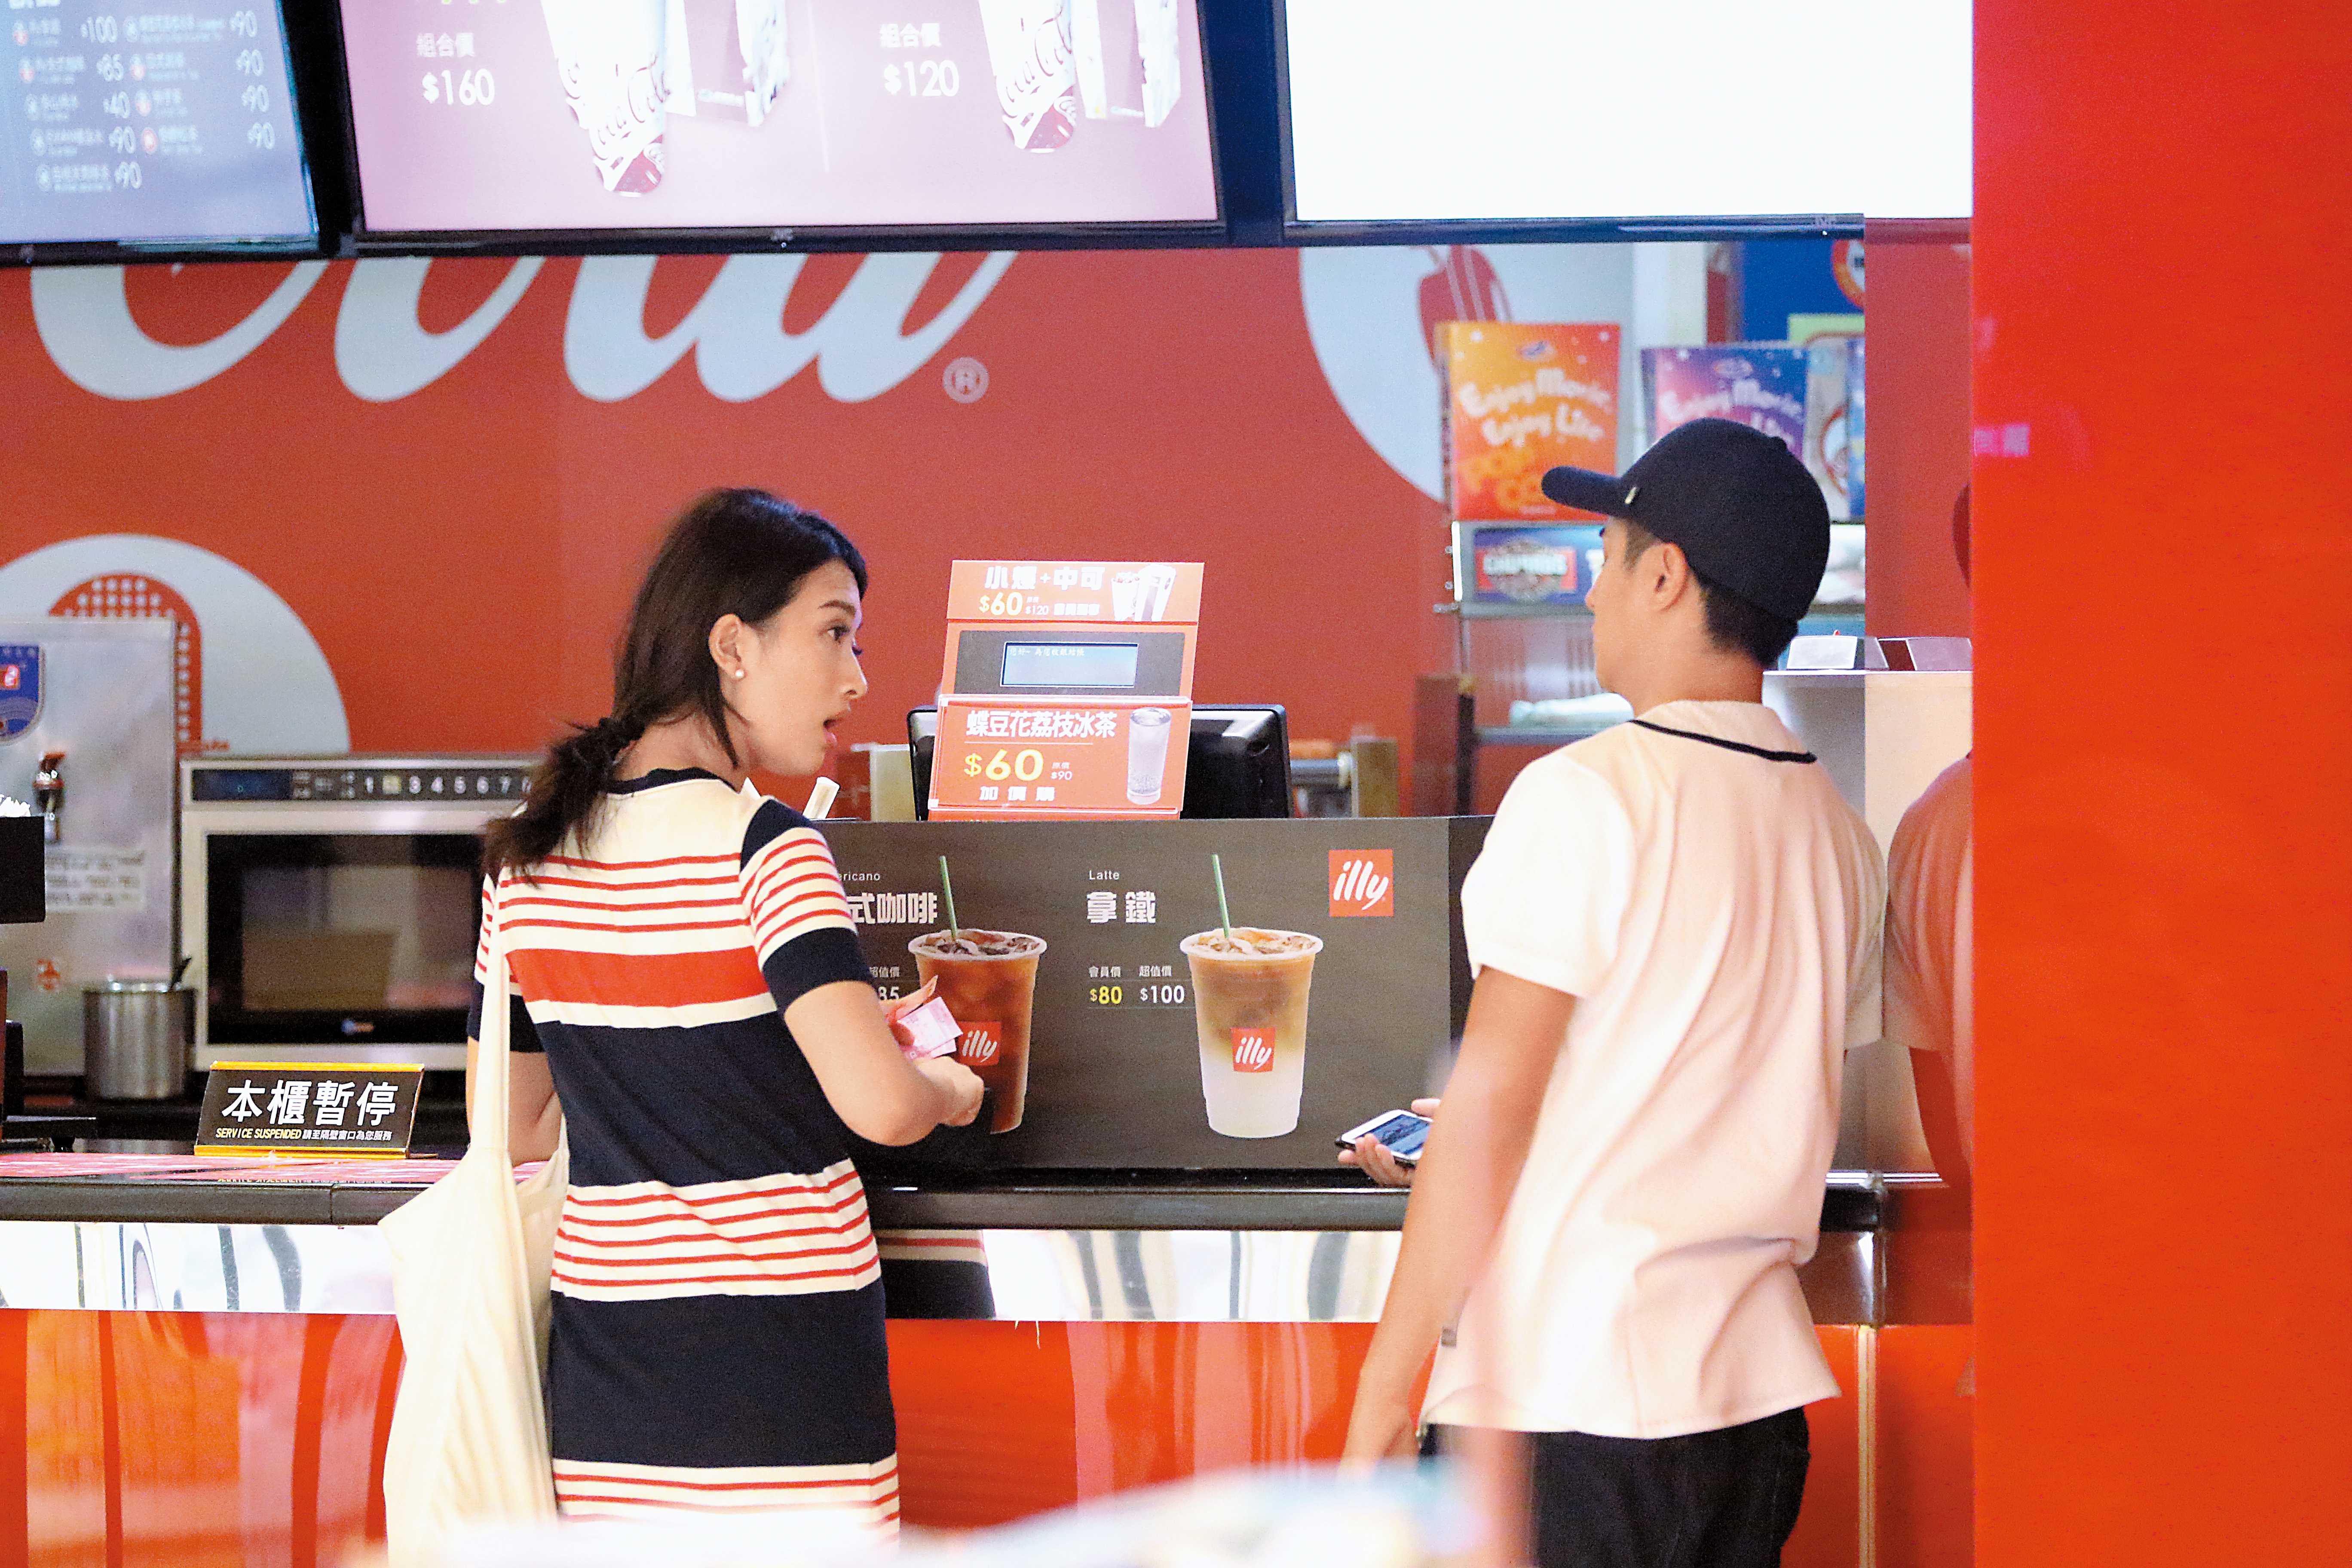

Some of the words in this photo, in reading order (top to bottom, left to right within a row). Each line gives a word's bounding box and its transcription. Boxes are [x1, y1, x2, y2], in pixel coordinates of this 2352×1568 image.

[416, 32, 475, 58] 組合價
[422, 68, 495, 105] $160
[884, 60, 959, 97] $120
[979, 591, 1023, 616] $60
[1025, 605, 1050, 616] $120
[966, 710, 1118, 738] 蝶豆花荔枝冰茶
[964, 749, 1044, 781] $60
[1051, 771, 1072, 781] $90
[838, 871, 881, 881] ericano
[1089, 870, 1120, 880] Latte
[1333, 860, 1389, 910] illy
[847, 892, 938, 925] 式咖啡
[1086, 891, 1157, 924] 拿鐵
[1139, 965, 1173, 977] 超值價
[878, 986, 900, 1001] 85
[1090, 986, 1123, 1005] $80
[1140, 985, 1185, 1004] $100
[962, 1029, 997, 1063] illy
[1235, 1036, 1272, 1070] illy
[221, 1079, 399, 1127] 本櫃暫停
[215, 1127, 252, 1139] SERVICE
[254, 1128, 302, 1140] SUSPENDED
